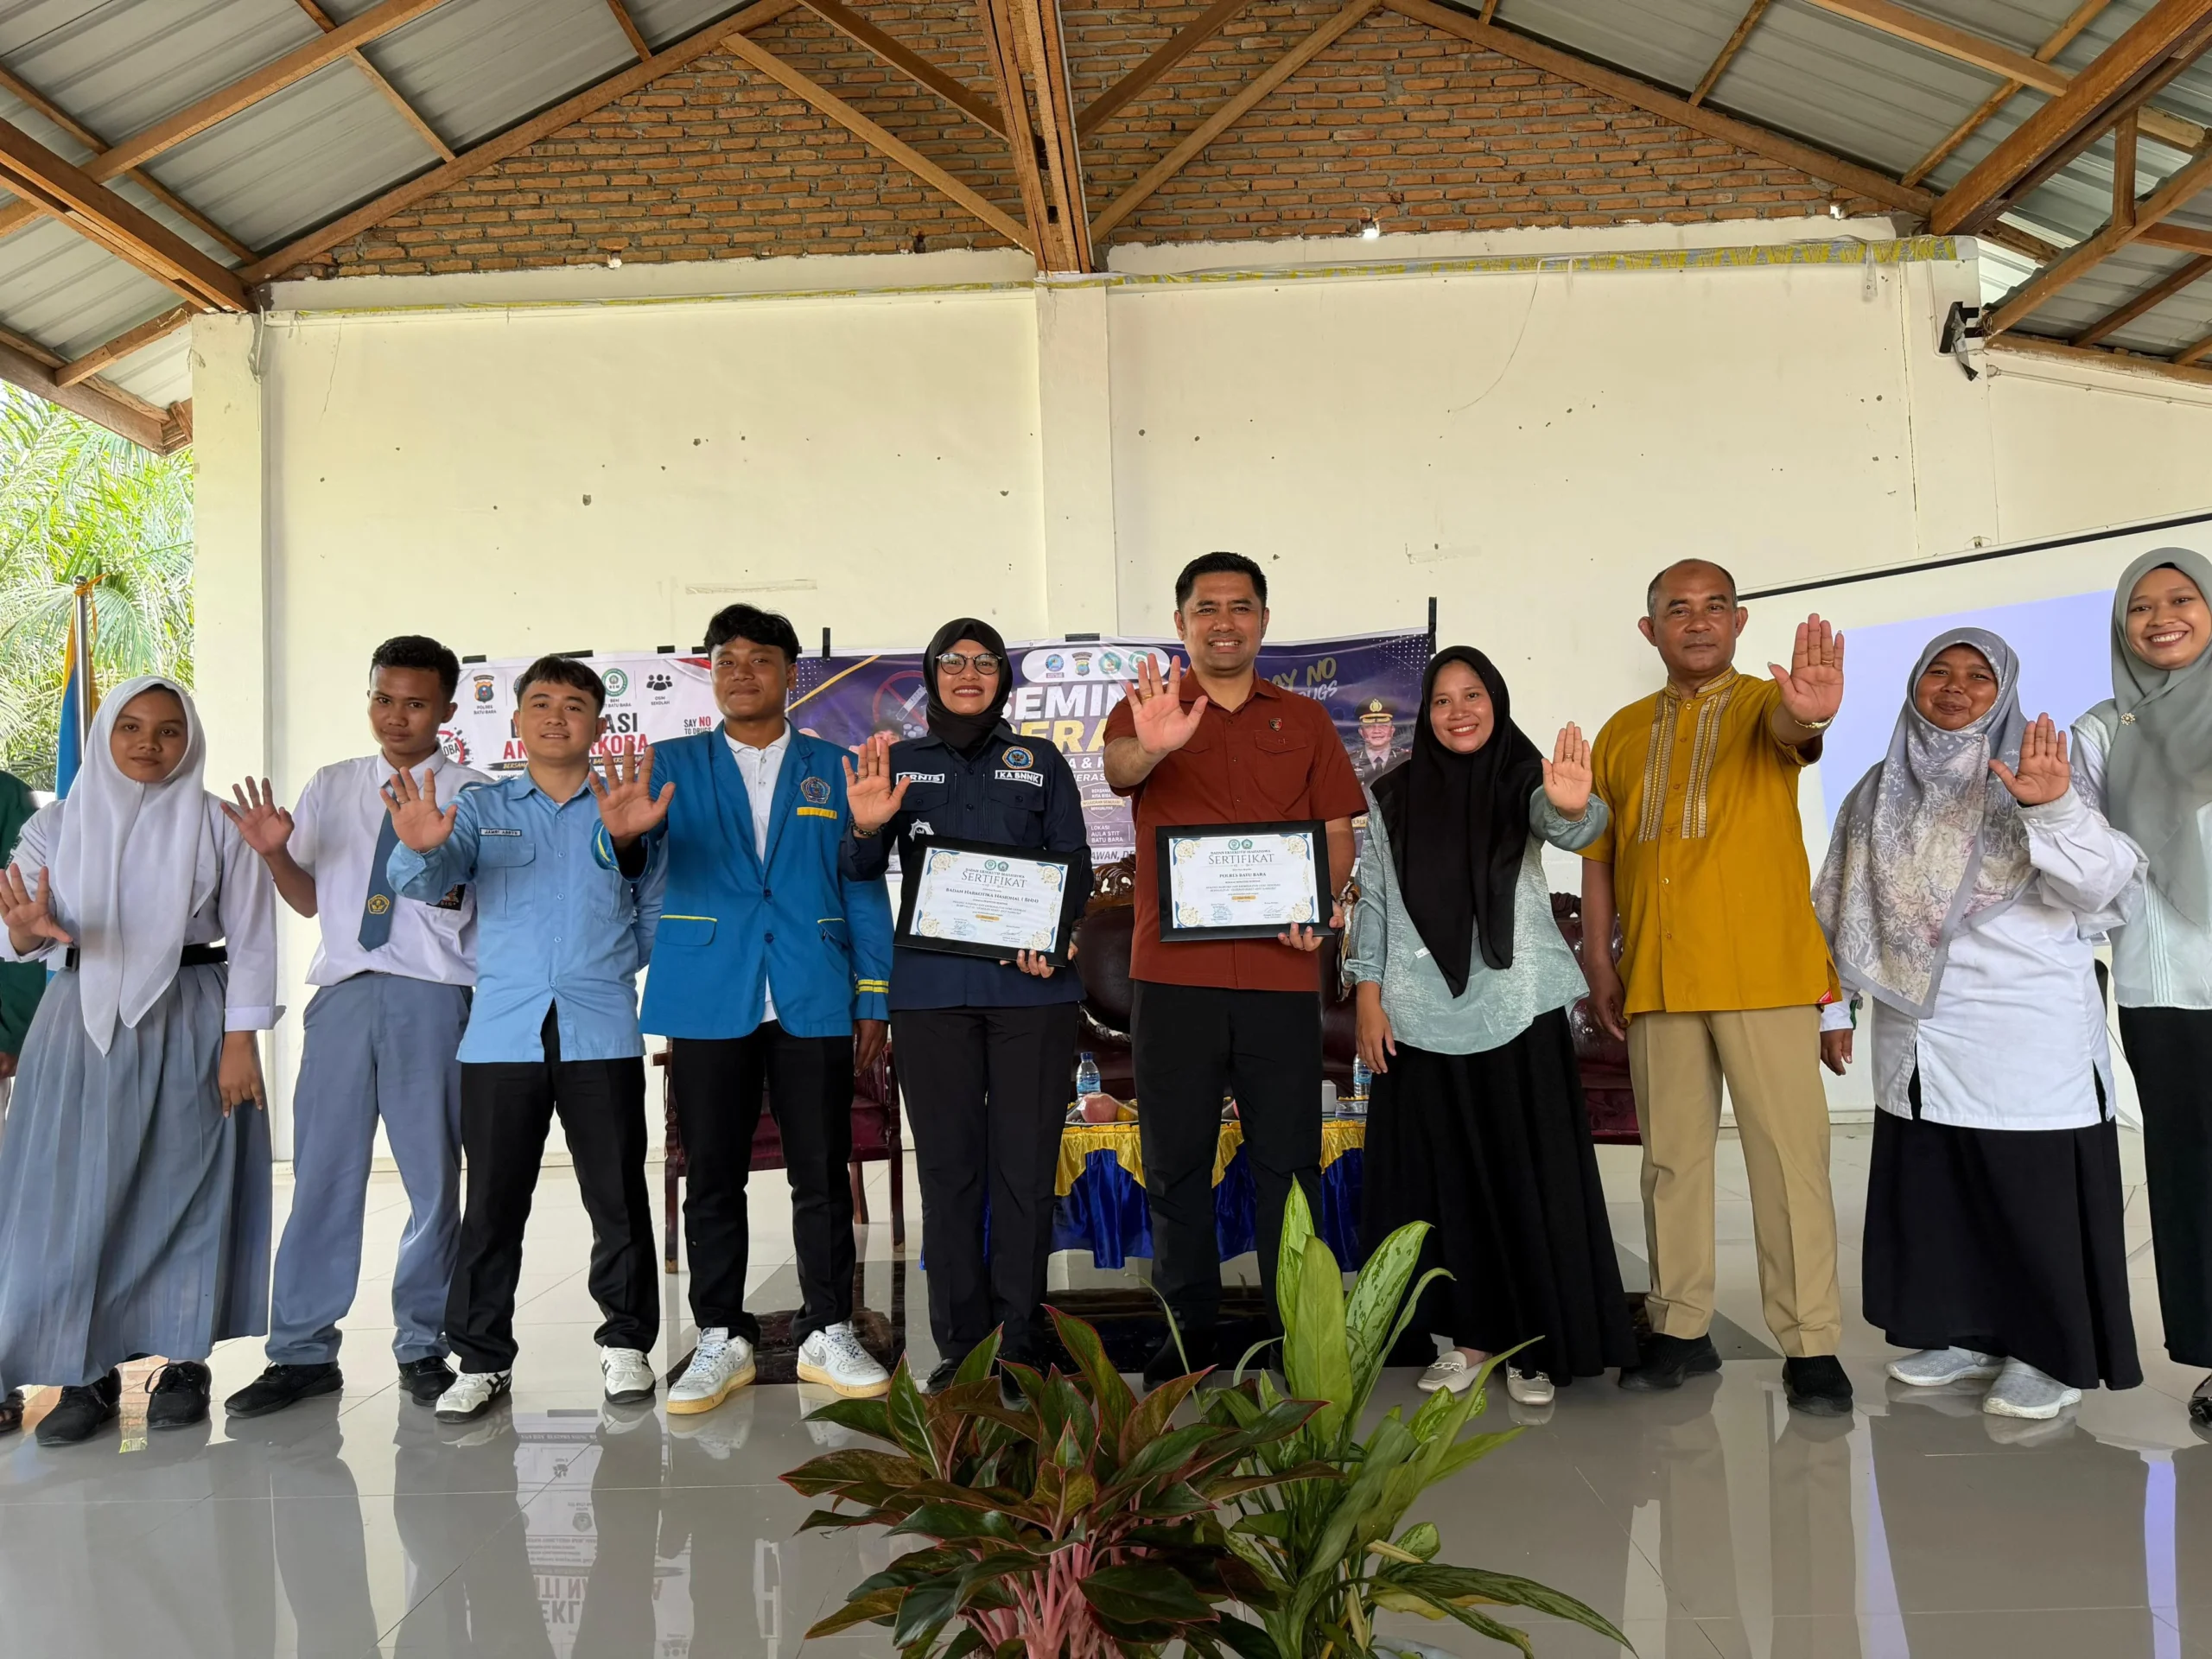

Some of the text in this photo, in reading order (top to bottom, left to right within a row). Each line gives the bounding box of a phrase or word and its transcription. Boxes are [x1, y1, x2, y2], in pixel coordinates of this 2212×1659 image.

[1263, 658, 1337, 691] AY NO
[1001, 683, 1127, 720] EMIN
[603, 713, 638, 734] ASI
[683, 716, 711, 728] SAY NO
[443, 742, 461, 756] OBA
[503, 740, 528, 760] AN
[1082, 757, 1092, 769] &
[1074, 773, 1106, 782] ERAS
[1091, 850, 1120, 861] AWAN,
[1208, 854, 1274, 865] SERTIFIKAT
[962, 871, 1027, 888] SERTIFIKAT
